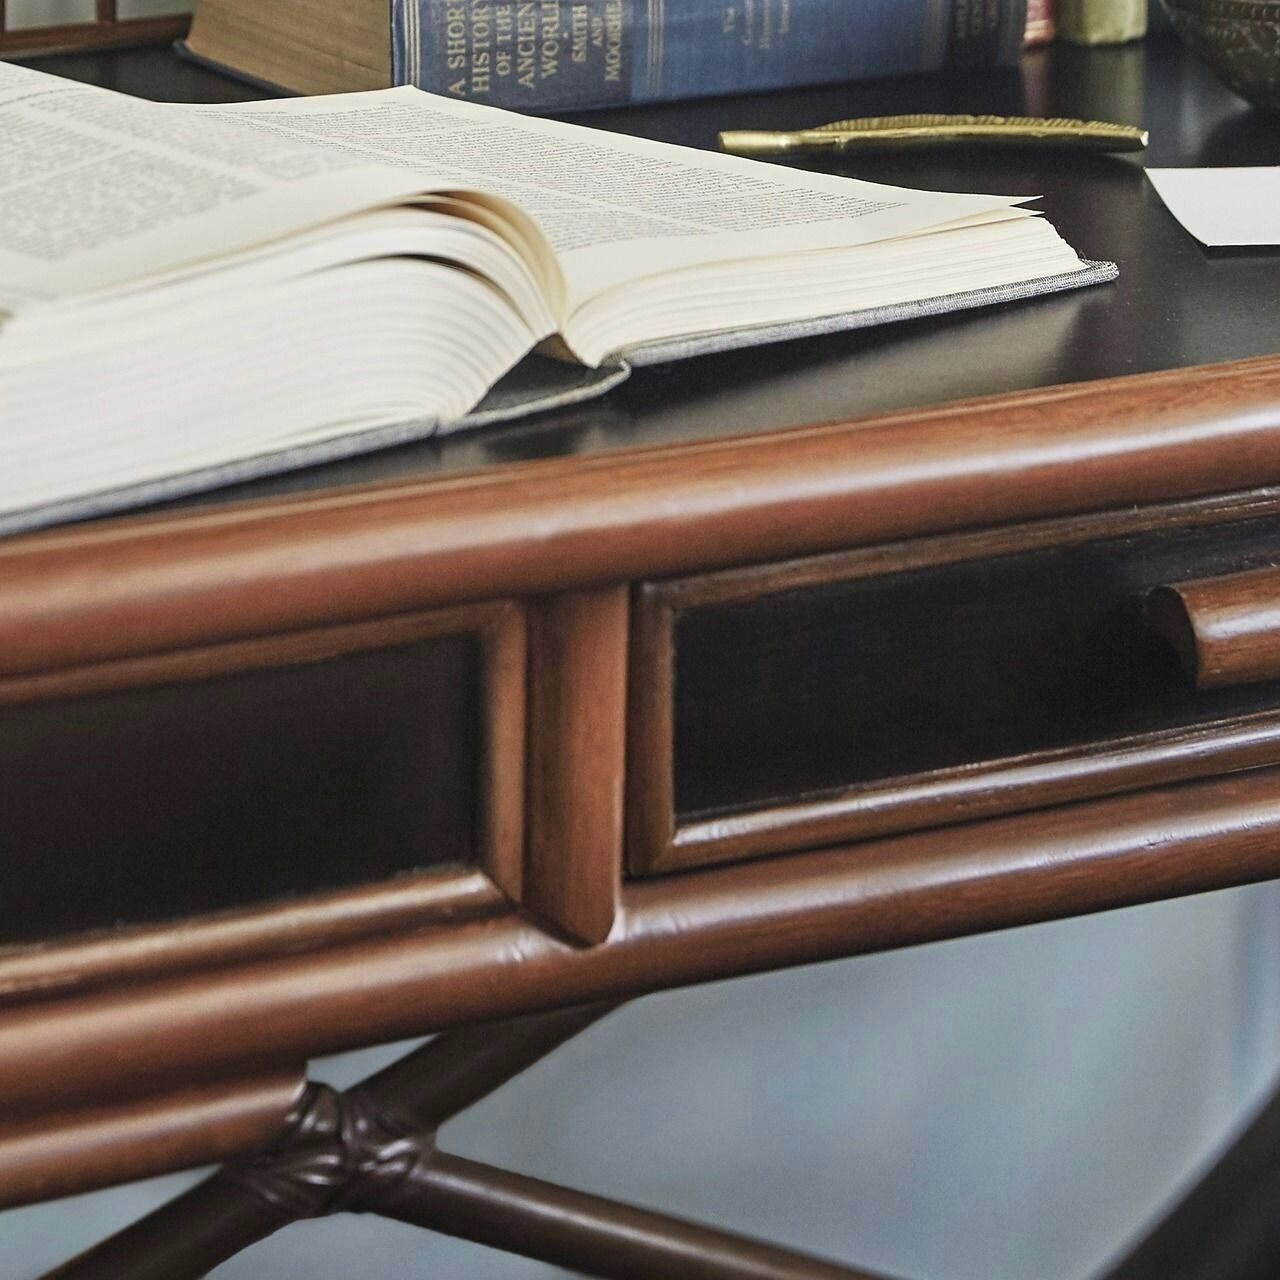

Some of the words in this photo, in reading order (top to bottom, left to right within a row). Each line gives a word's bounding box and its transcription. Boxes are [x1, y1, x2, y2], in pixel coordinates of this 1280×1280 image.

[496, 4, 512, 43] THE
[572, 4, 588, 63] SMITH
[591, 17, 603, 47] AND
[496, 50, 511, 76] OF
[448, 78, 466, 96] A
